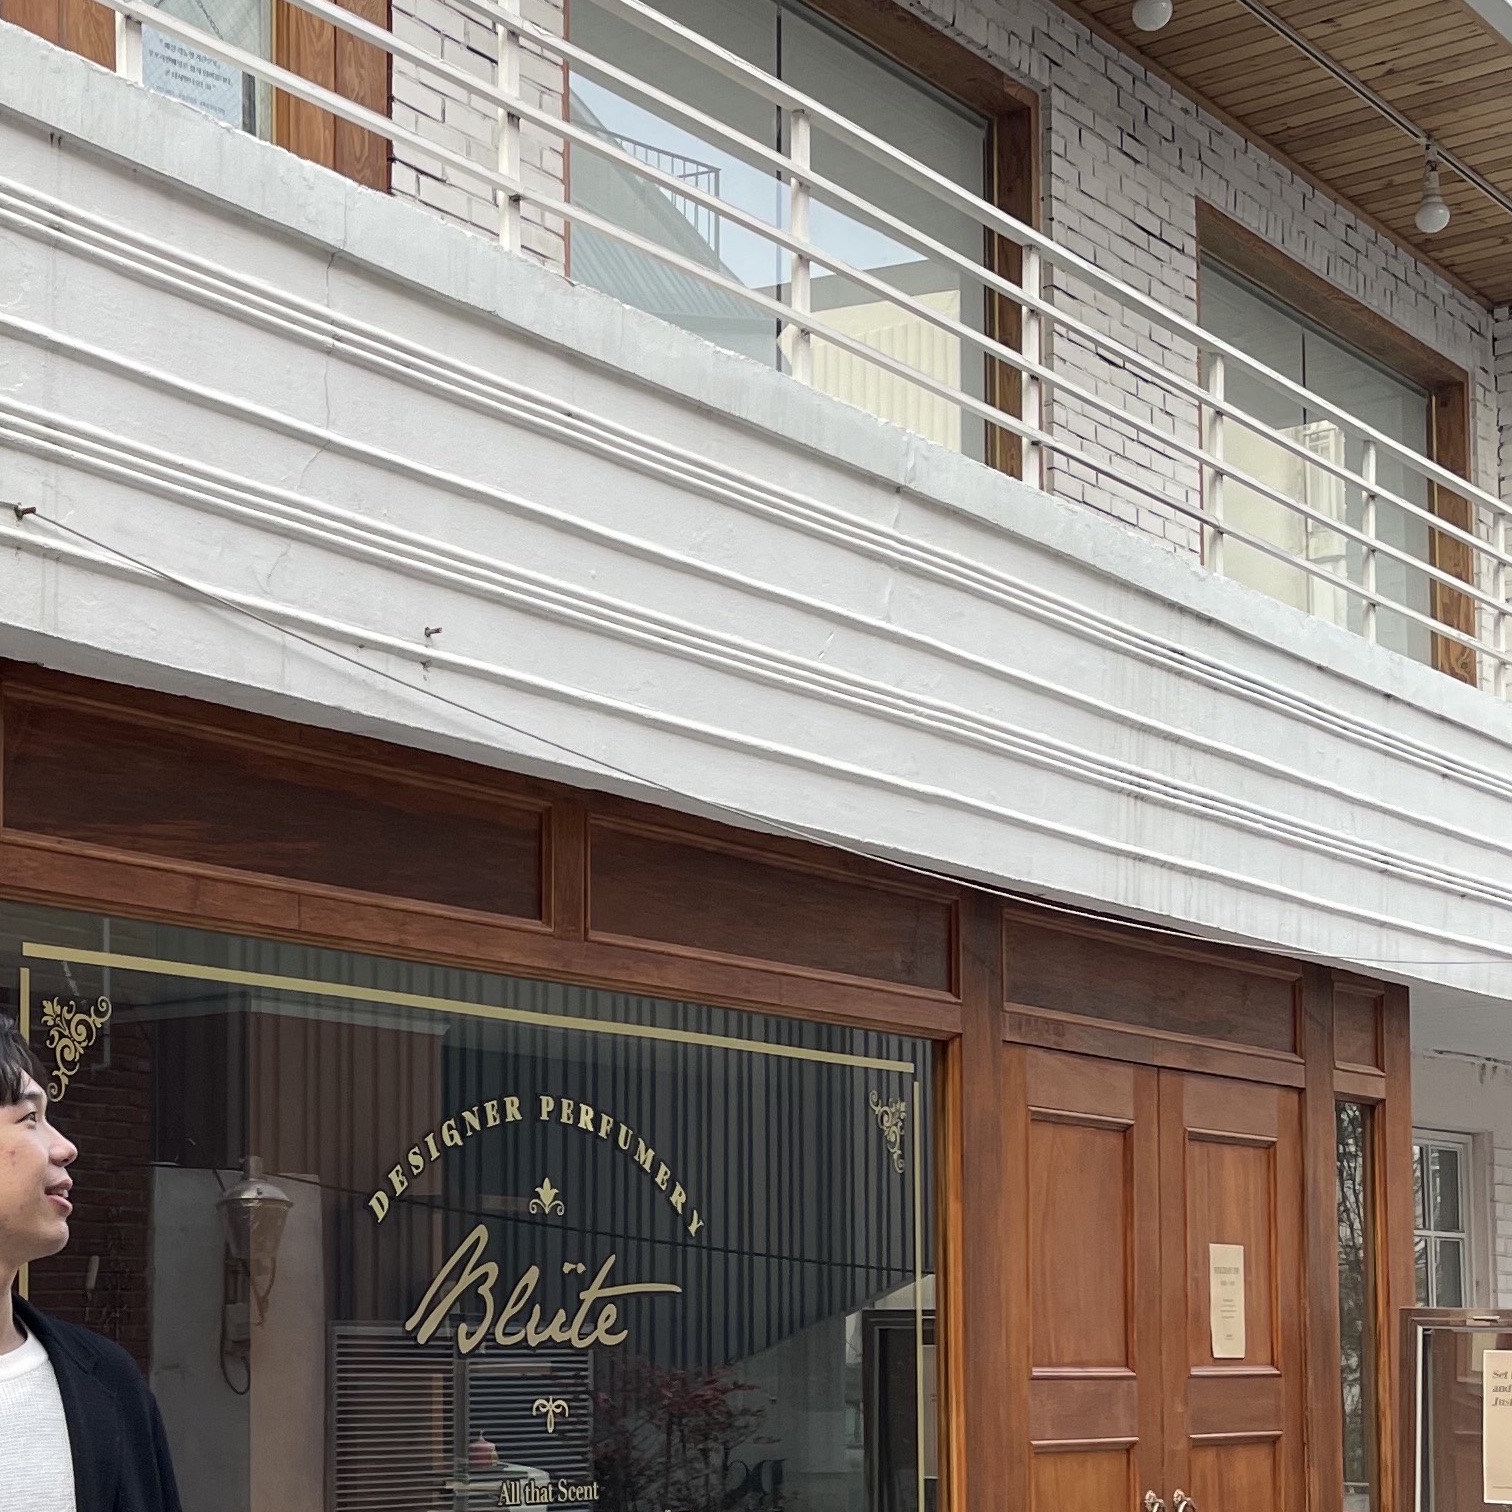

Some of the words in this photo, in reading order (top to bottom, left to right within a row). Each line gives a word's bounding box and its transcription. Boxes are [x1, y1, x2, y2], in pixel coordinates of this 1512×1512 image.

[368, 1095, 523, 1223] DESIGNER
[539, 1095, 706, 1238] PERFUMERY
[498, 1481, 524, 1506] All
[525, 1478, 554, 1504] that
[558, 1481, 599, 1502] Scent
